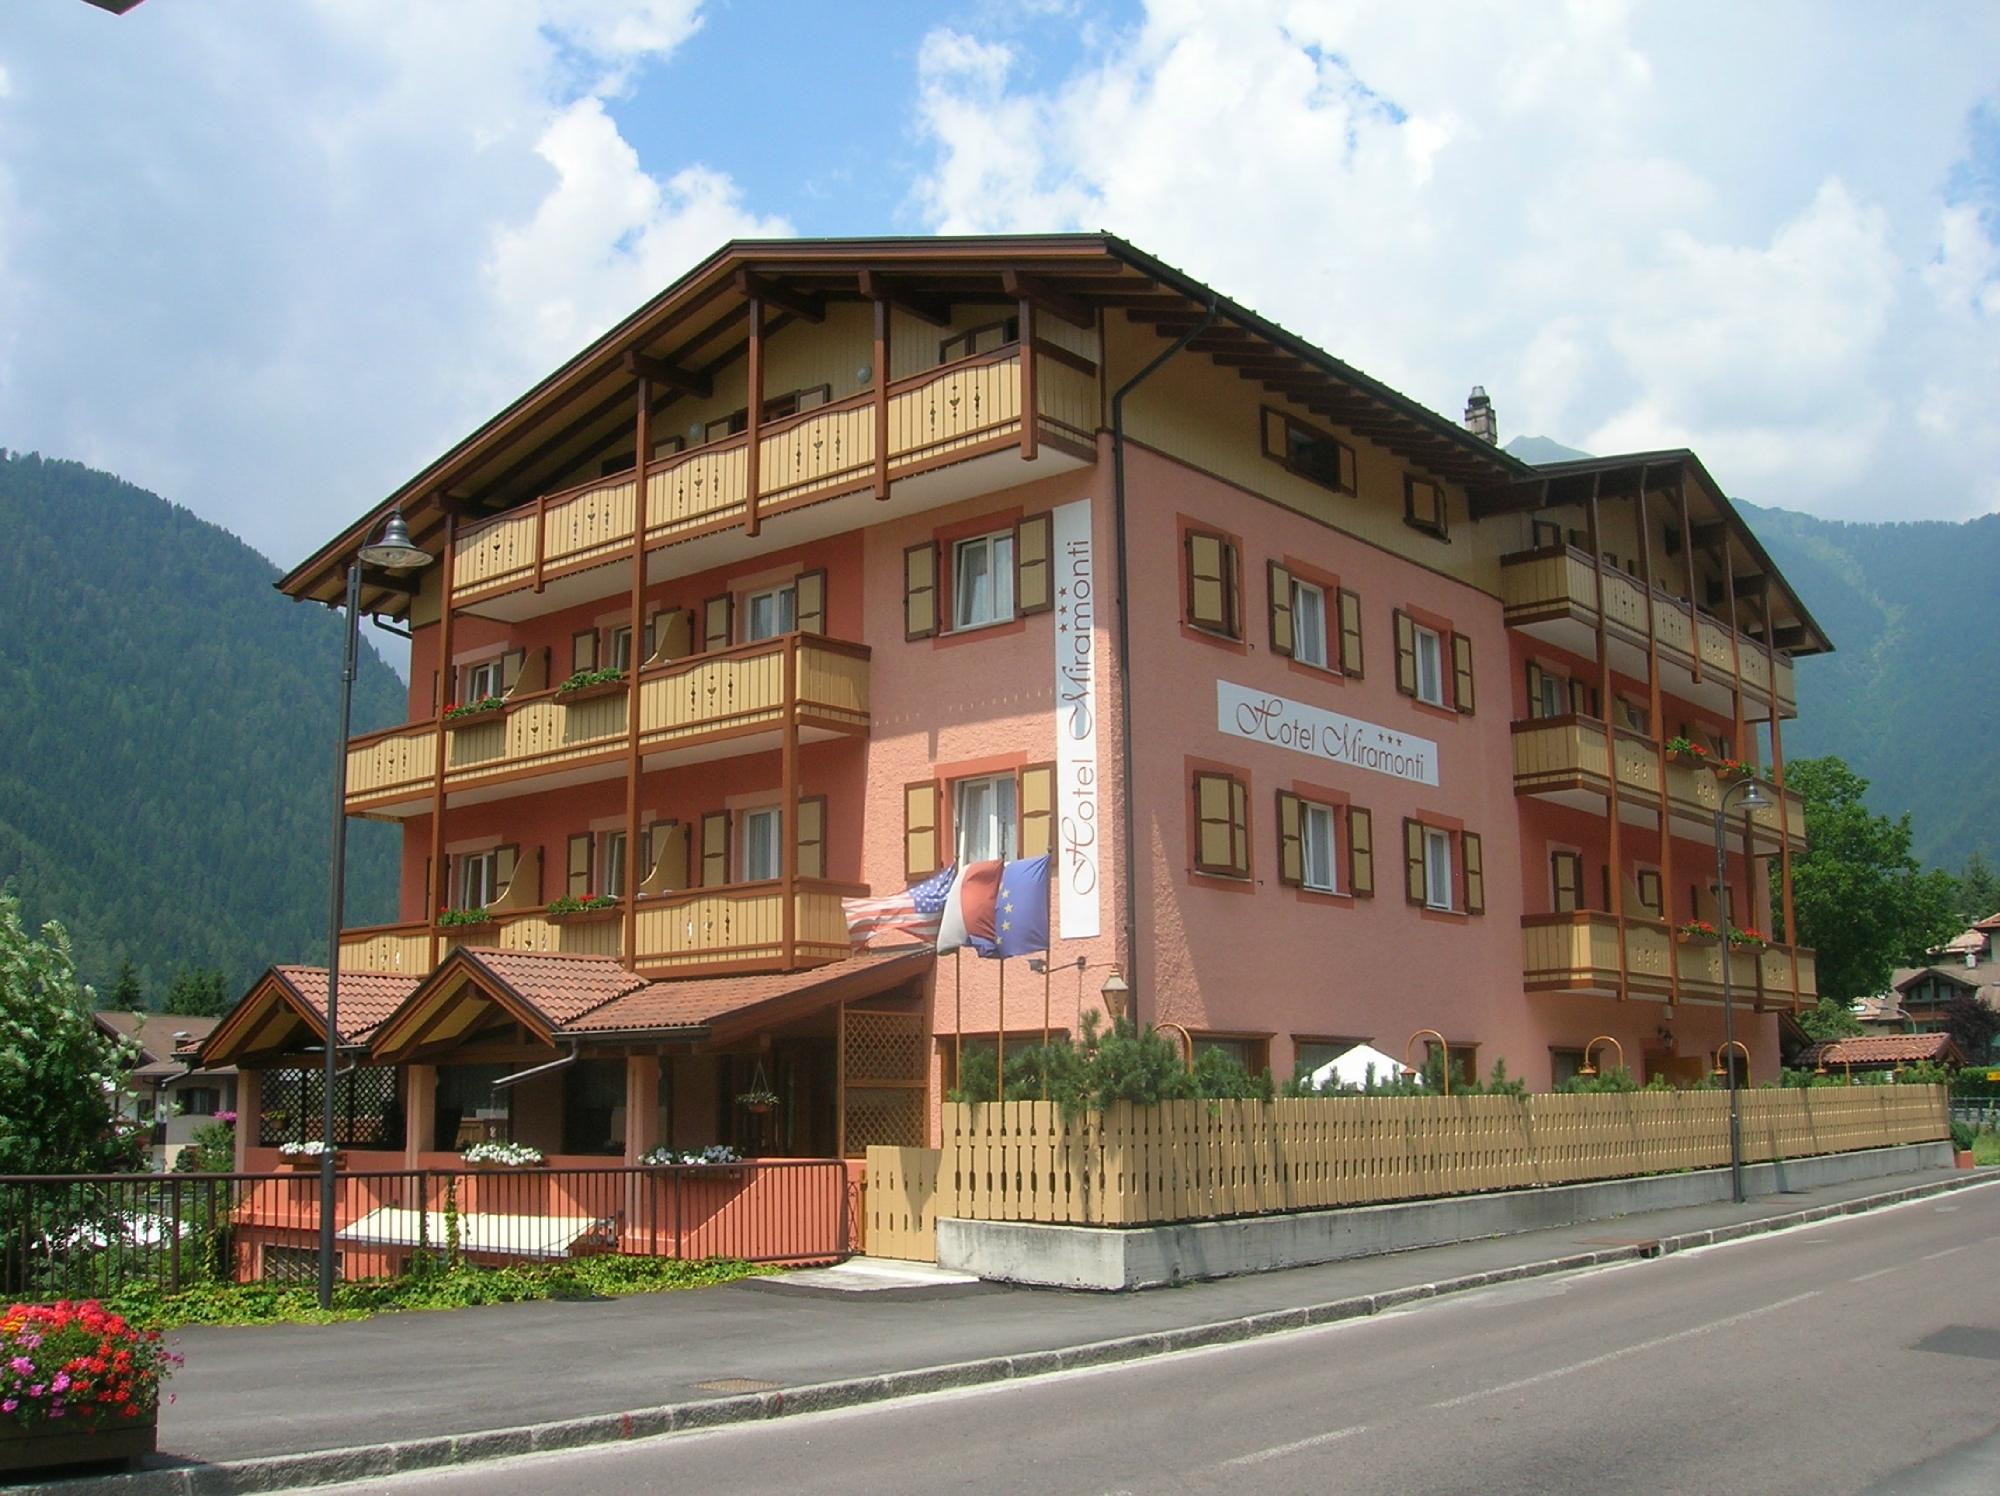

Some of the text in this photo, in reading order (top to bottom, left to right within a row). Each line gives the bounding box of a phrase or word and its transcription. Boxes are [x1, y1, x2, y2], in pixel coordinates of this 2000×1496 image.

[1061, 540, 1096, 896] Hotel Miramonti
[1235, 698, 1424, 780] Hotel Miramonti
